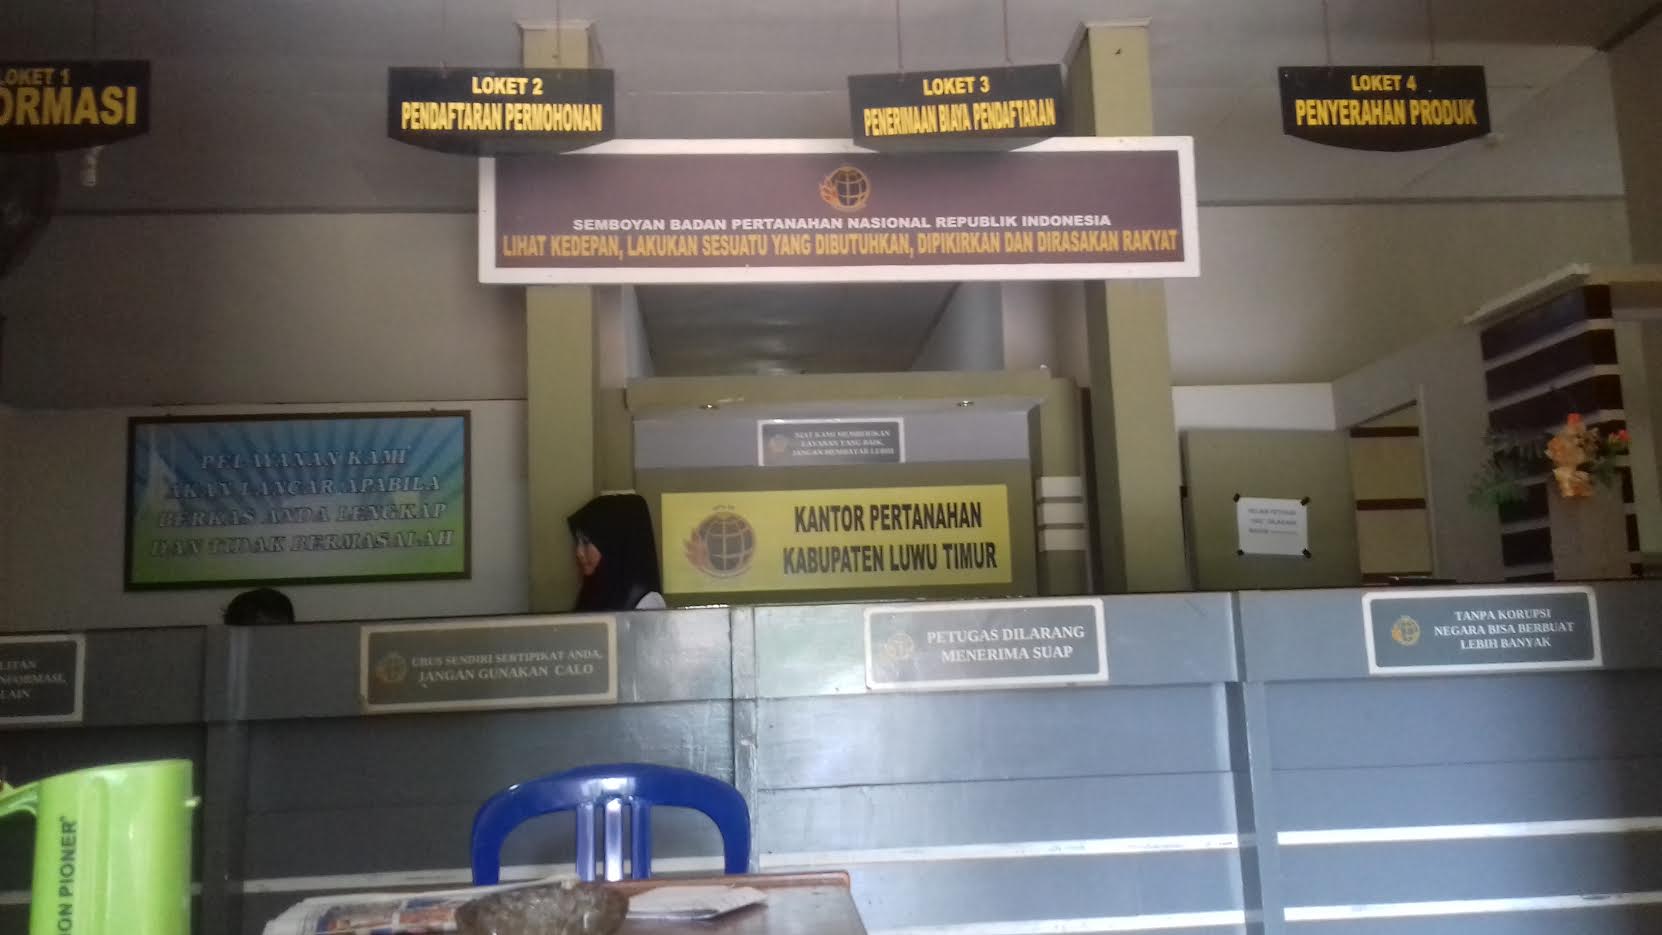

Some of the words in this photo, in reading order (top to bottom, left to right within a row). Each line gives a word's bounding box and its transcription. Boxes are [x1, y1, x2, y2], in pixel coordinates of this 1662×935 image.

[0, 68, 54, 86] OKET
[61, 68, 69, 85] 1
[472, 76, 528, 95] LOKET
[532, 78, 543, 95] 2
[923, 76, 976, 96] LOKET
[980, 75, 990, 93] 3
[1351, 75, 1401, 91] LOKET
[1406, 75, 1417, 91] 4
[402, 101, 502, 130] PENDAFTARAN
[505, 103, 602, 131] PERMOHONAN
[864, 104, 938, 136] PENERIMAAN
[938, 103, 971, 133] BIAYA
[972, 98, 1056, 130] PENDAFTARAN
[1296, 99, 1406, 126] PENYERAHAN
[1410, 99, 1477, 126] PRODUK
[573, 219, 665, 231] SEMBOYAN
[670, 218, 727, 231] BADAN
[731, 217, 843, 230] PERTANAHAN
[847, 216, 931, 229] NASIONAL
[935, 215, 1018, 228] REPUBLIK
[1022, 214, 1111, 227] INDONESIA
[503, 235, 546, 257] LIHAT
[551, 235, 623, 260] KEDEPAN,
[627, 235, 698, 257] LAKUKAN
[702, 234, 767, 256] SESUATU
[773, 234, 811, 256] YANG
[816, 232, 914, 259] DIBUTUHKAN,
[918, 231, 1000, 255] DIPIKIRKAN
[1005, 231, 1033, 253] DAN
[1037, 230, 1118, 253] DIRASAKAN
[1123, 229, 1177, 251] RAKYAT
[348, 448, 408, 467] KAMI
[237, 478, 335, 498] LANCAR
[347, 475, 441, 495] APABILA
[795, 503, 864, 533] KANTOR
[870, 501, 982, 532] PERTANAHAN
[783, 543, 884, 574] KABUPATEN
[890, 543, 938, 572] LUWU
[942, 541, 998, 570] TIMUR
[1454, 610, 1496, 622] TANPA
[1498, 608, 1551, 620] KORUPSI
[927, 629, 998, 644] PETUGAS
[1003, 625, 1084, 641] DILARANG
[1434, 624, 1485, 637] NEGARA
[1488, 623, 1515, 635] BISA
[1518, 621, 1575, 634] BERBUAT
[1460, 638, 1498, 650] LEBIH
[1501, 635, 1551, 648] BANYAK
[412, 654, 443, 668] URUS
[446, 653, 492, 667] SENDIRI
[495, 651, 564, 665] SERTIPIKAT
[942, 647, 1029, 663] MENERIMA
[1033, 645, 1073, 659] SUAP
[418, 668, 475, 682] JANGAN
[478, 666, 548, 680] GUNAKAN
[554, 663, 594, 676] CALO
